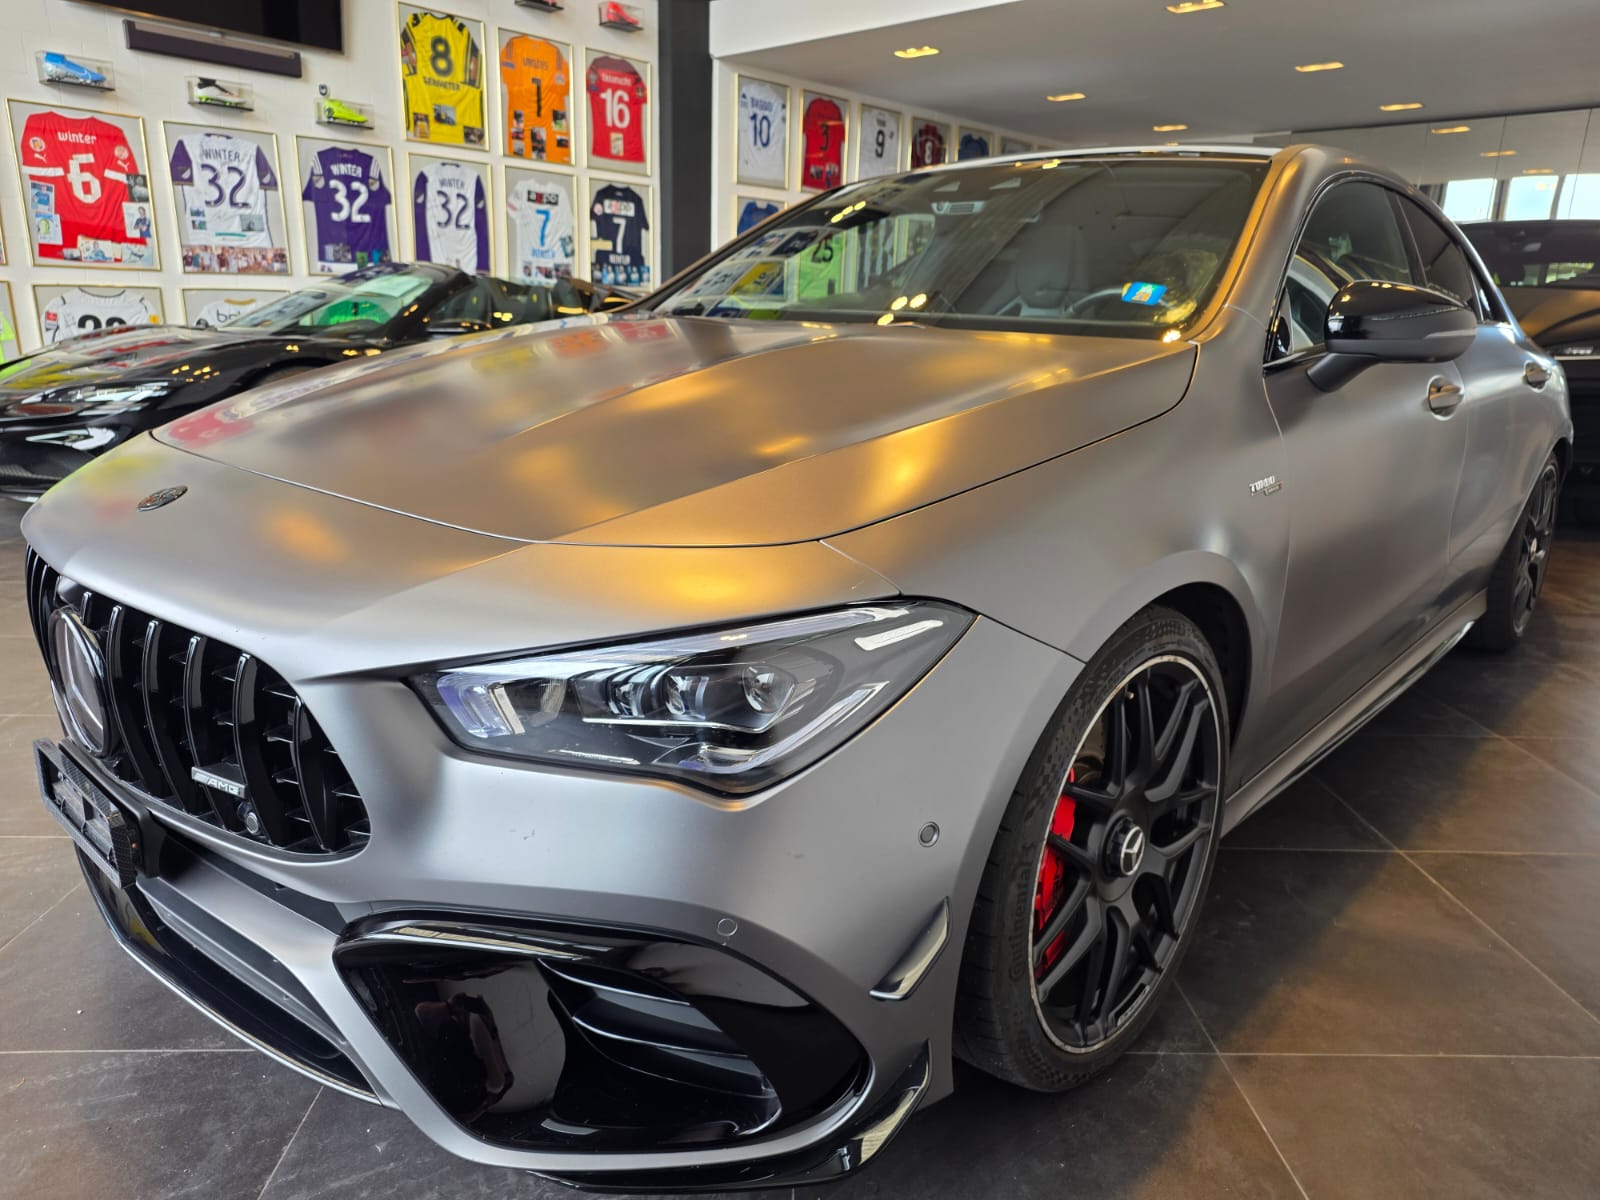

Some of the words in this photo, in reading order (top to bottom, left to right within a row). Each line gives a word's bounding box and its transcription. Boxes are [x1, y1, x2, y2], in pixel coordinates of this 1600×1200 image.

[429, 34, 454, 78] 8
[531, 76, 542, 118] 1
[600, 88, 630, 129] 16
[57, 130, 97, 145] winter
[750, 112, 771, 148] 10
[819, 123, 829, 152] 3
[875, 129, 885, 159] 9
[202, 148, 242, 163] WINTER
[329, 163, 362, 178] WINTER
[67, 153, 102, 204] 6
[201, 163, 249, 209] 32
[329, 179, 371, 223] 32
[437, 190, 470, 230] 32
[535, 209, 551, 247] 7
[612, 217, 627, 254] 7
[207, 778, 240, 795] AMG
